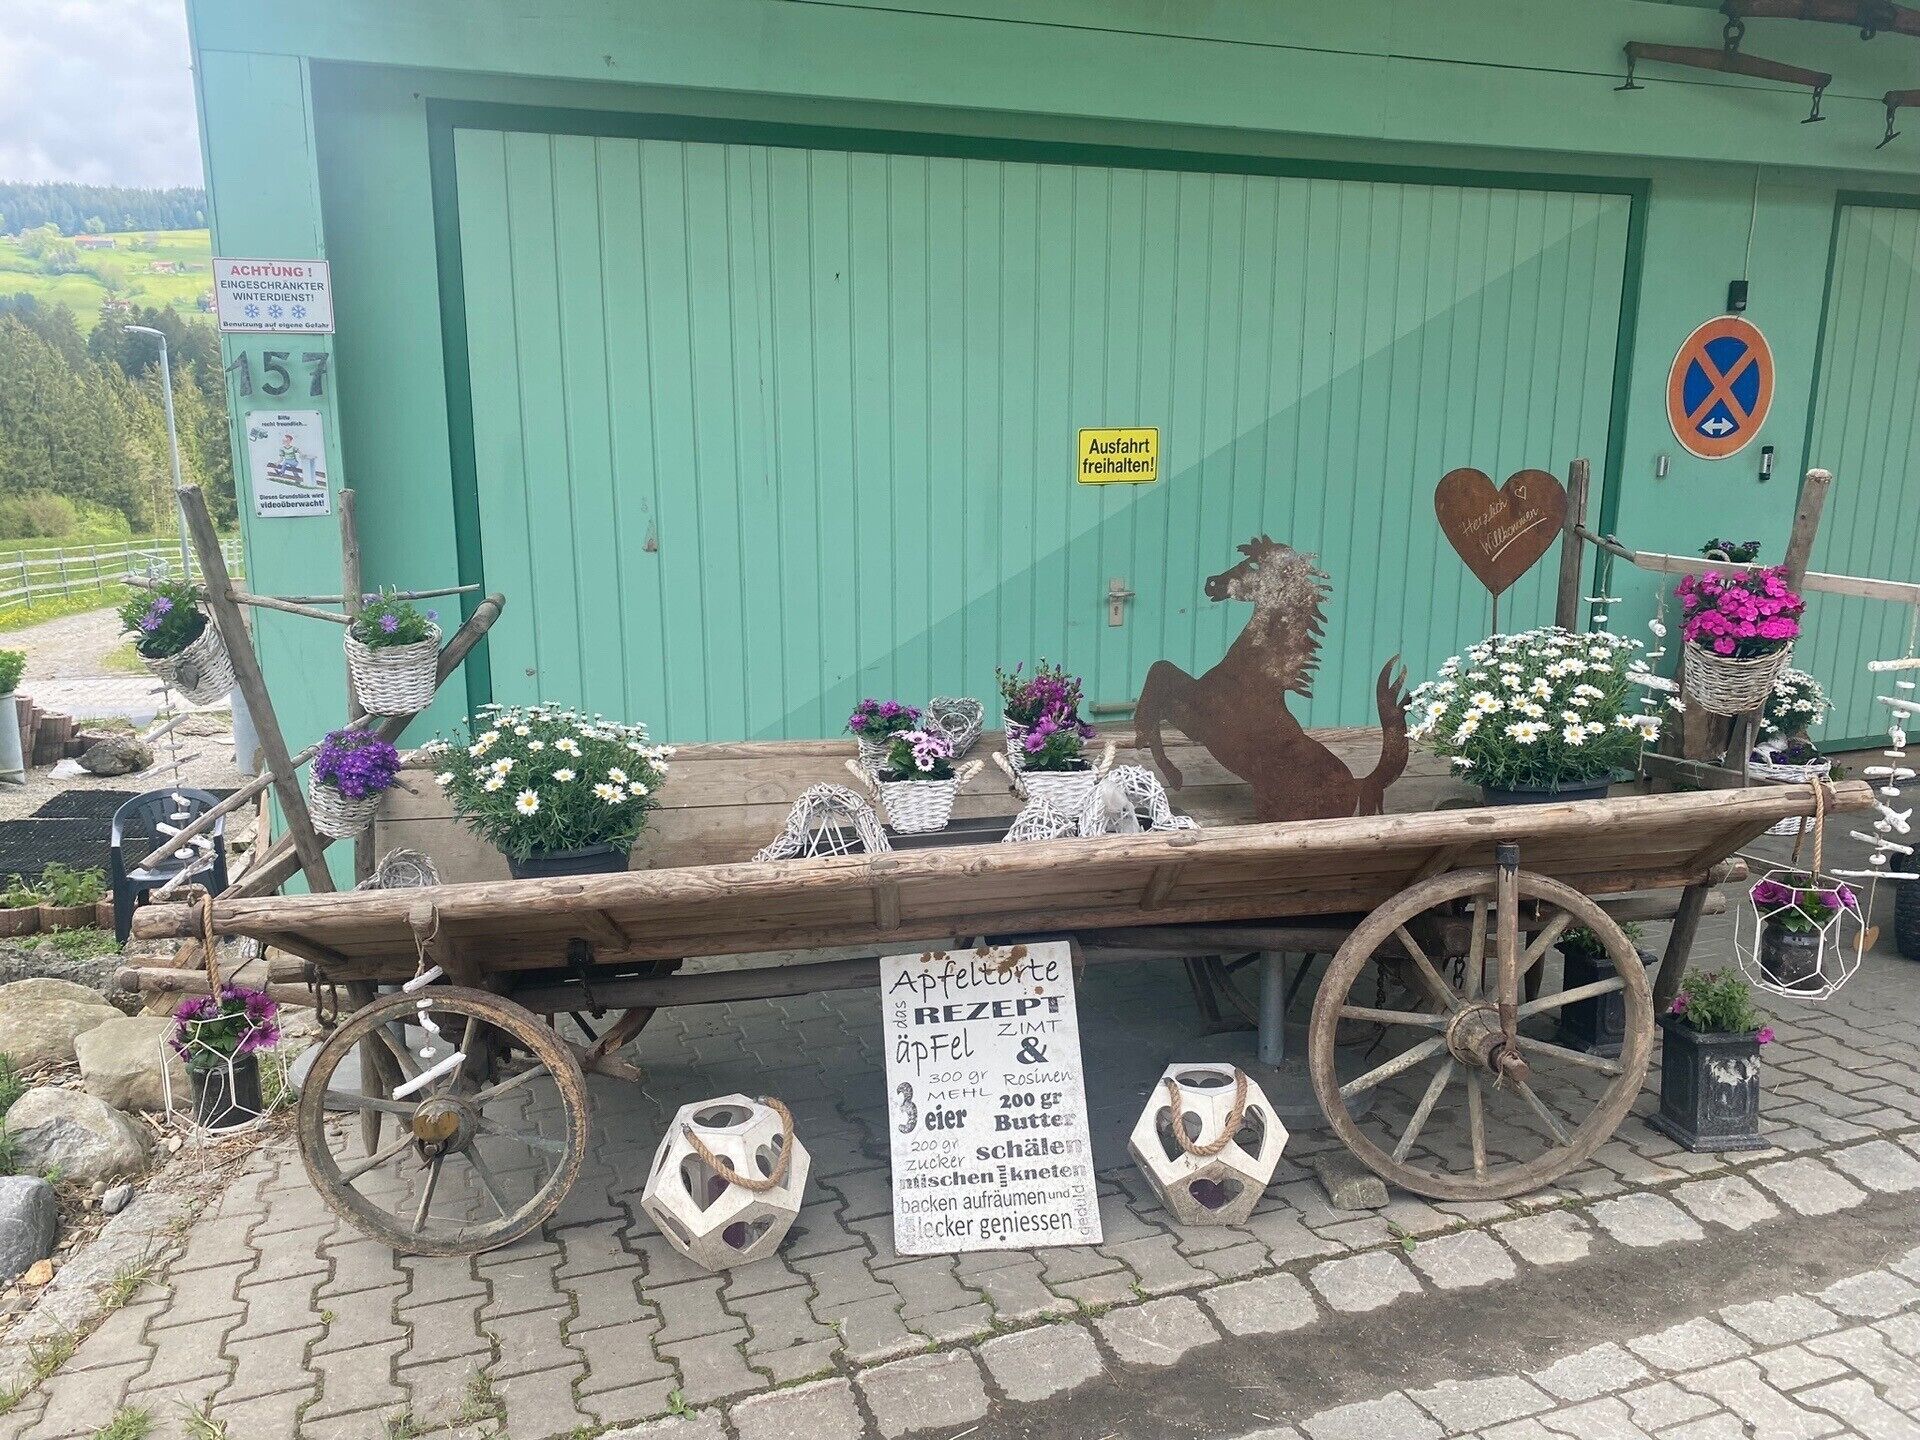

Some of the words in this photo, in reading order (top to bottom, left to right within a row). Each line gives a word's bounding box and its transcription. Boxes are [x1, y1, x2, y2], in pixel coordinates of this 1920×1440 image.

[230, 265, 304, 277] ACHTUNG
[232, 292, 315, 302] WINTERDIENST!
[223, 321, 263, 329] Benutzung
[265, 320, 278, 328] auf
[278, 321, 303, 329] eigene
[305, 320, 329, 328] Gefahr
[225, 350, 330, 397] 157
[1089, 438, 1150, 454] Ausfahrt
[1082, 456, 1154, 473] freihalten!
[260, 500, 325, 508] videoüberwacht!
[889, 958, 1059, 1003] Apfeltorte
[914, 995, 1065, 1025] REZEPT
[997, 1019, 1063, 1037] ZIMT
[1016, 1036, 1049, 1065] &
[929, 1070, 963, 1084] 300
[968, 1069, 988, 1085] gr
[1003, 1068, 1073, 1086] Rosinen
[927, 1087, 993, 1101] MEHL
[1000, 1092, 1036, 1109] 200
[1040, 1091, 1063, 1110] gr
[896, 1081, 918, 1134] 3
[925, 1104, 968, 1131] eier
[994, 1112, 1077, 1132] Butter
[911, 1139, 938, 1152] 200
[942, 1139, 959, 1154] gr
[976, 1137, 1082, 1161] schälen
[900, 1171, 994, 1190] mischen
[1010, 1163, 1088, 1181] kneten
[900, 1194, 958, 1214] backen
[963, 1190, 1047, 1209] aufräumen
[1048, 1189, 1070, 1200] und
[980, 1211, 1073, 1239] geniessen
